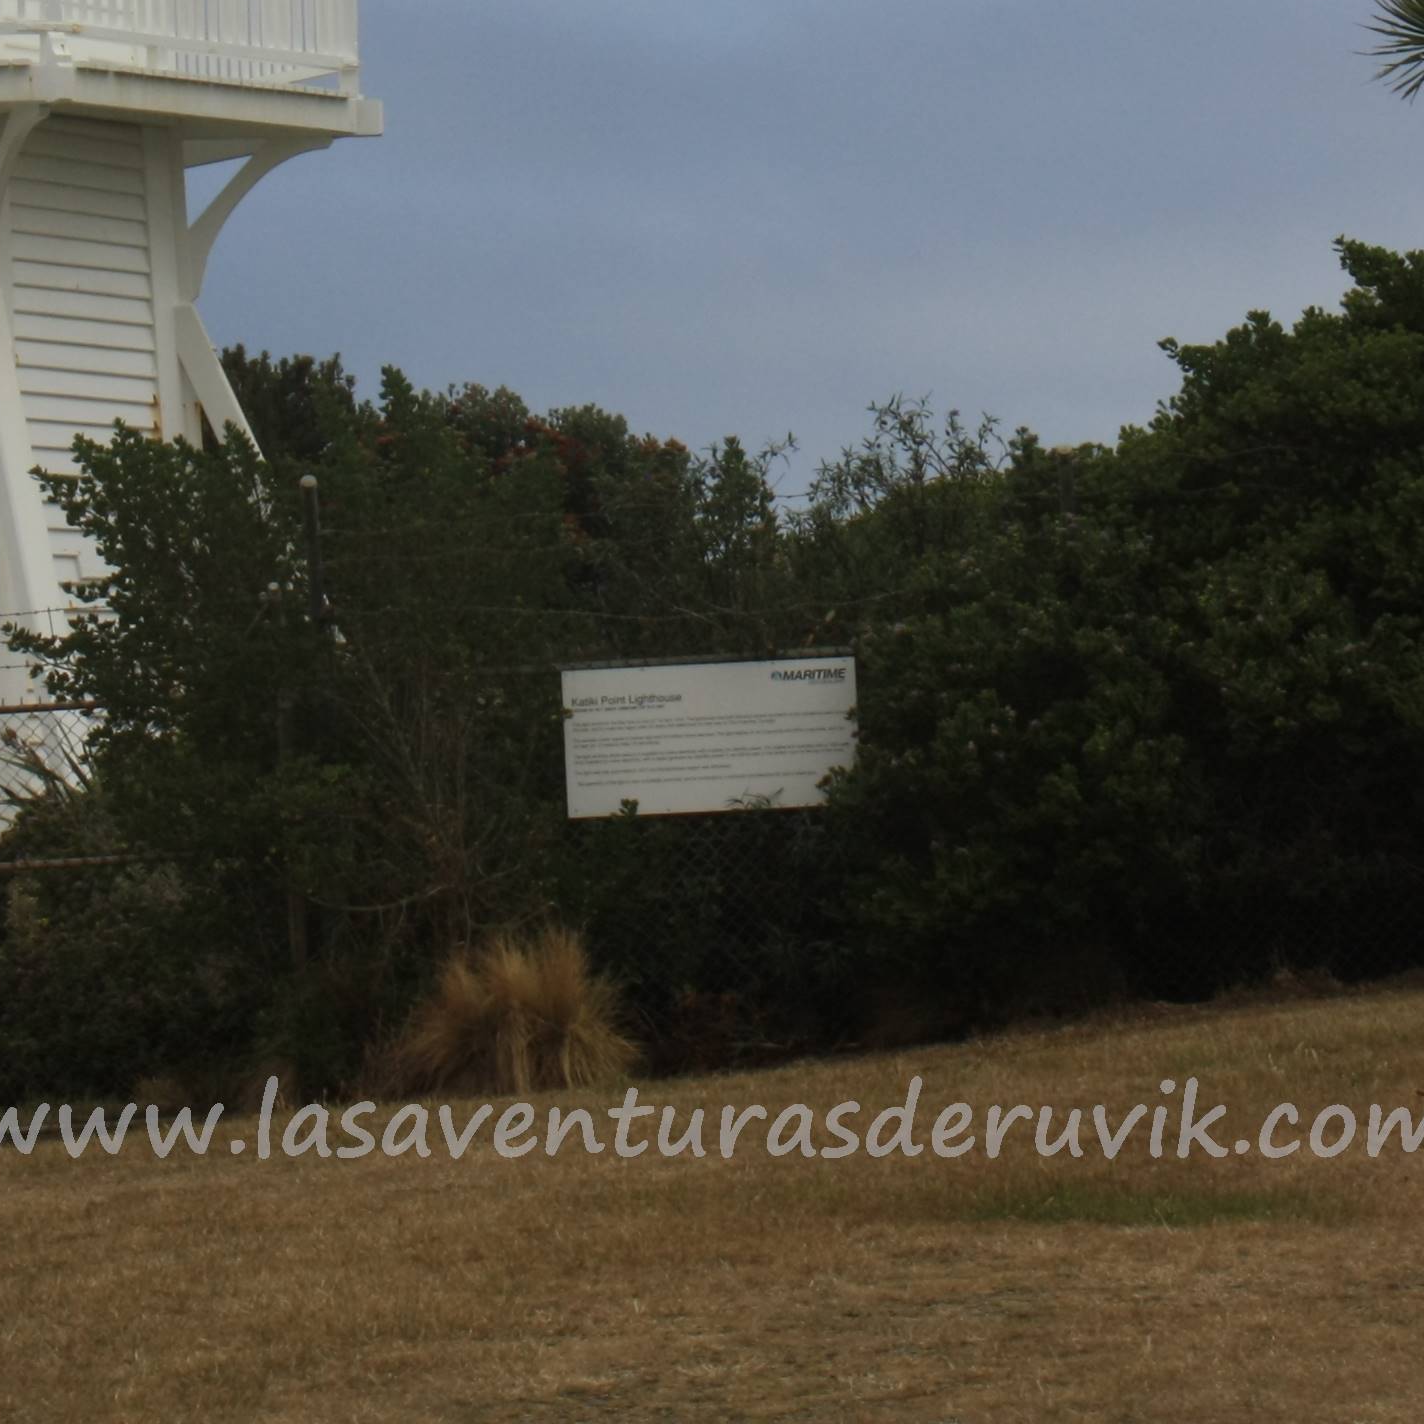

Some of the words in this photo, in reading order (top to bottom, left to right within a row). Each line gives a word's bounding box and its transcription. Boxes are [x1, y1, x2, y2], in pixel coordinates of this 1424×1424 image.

[782, 668, 846, 681] MARITIME
[571, 696, 597, 707] Katiki
[601, 695, 626, 706] Point
[628, 693, 682, 705] Lighthouse
